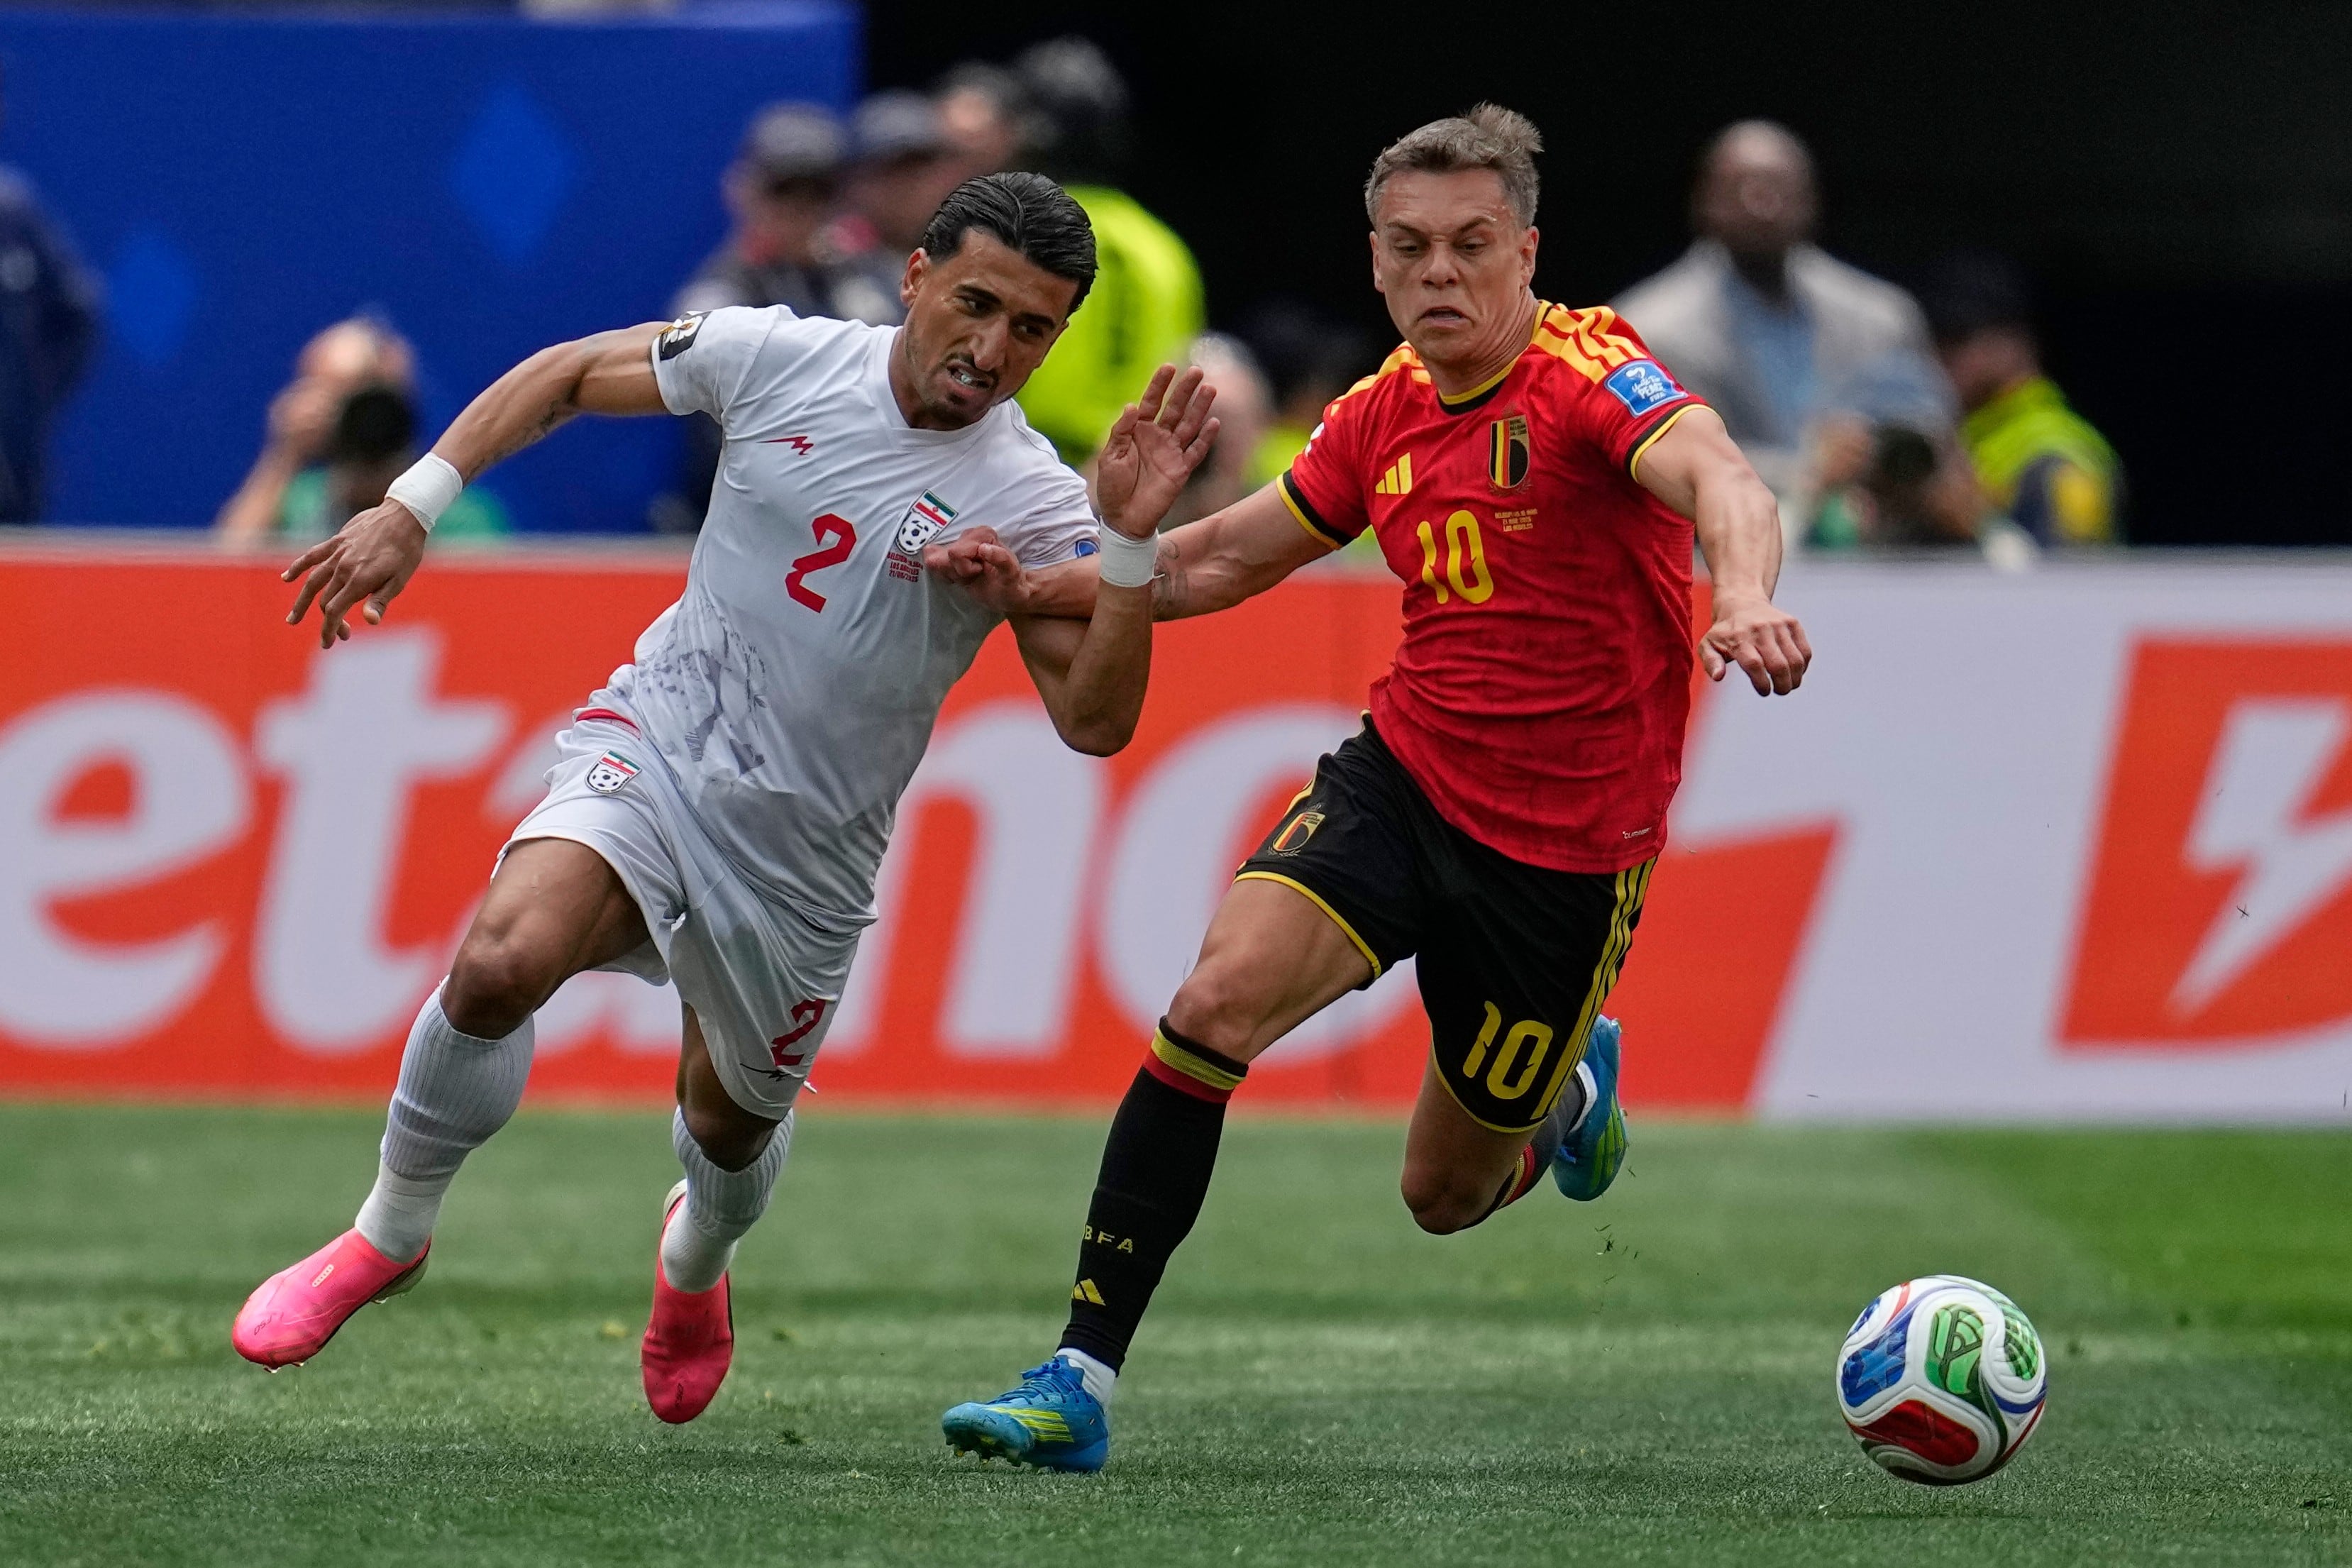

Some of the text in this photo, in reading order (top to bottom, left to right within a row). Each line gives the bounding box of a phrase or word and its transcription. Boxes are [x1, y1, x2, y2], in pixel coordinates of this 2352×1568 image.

[785, 513, 857, 612] 2
[1417, 510, 1494, 604] 10
[771, 998, 827, 1067] 2
[1462, 1000, 1554, 1100] 10
